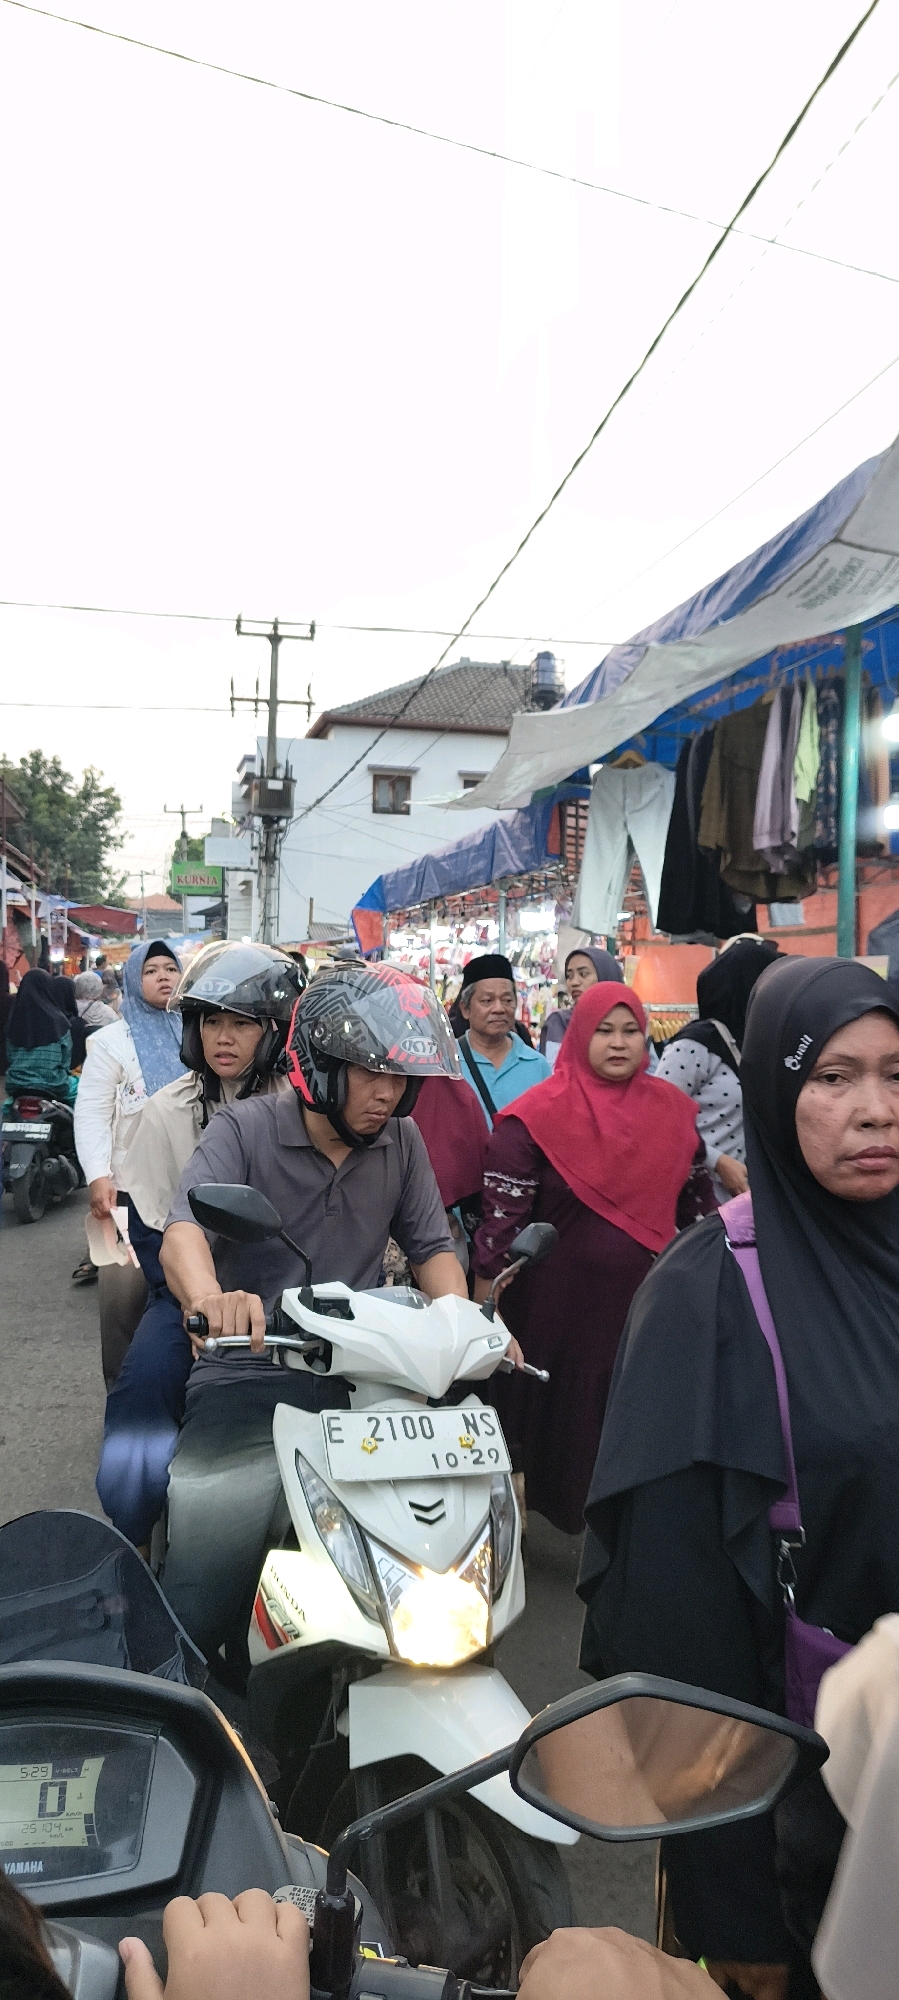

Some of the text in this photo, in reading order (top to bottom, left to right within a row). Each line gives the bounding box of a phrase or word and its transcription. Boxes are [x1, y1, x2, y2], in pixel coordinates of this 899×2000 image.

[176, 874, 219, 886] KURNIA
[327, 1412, 497, 1444] E 2100 NS
[38, 1780, 68, 1819] 0
[4, 1860, 44, 1876] YAMAHA
